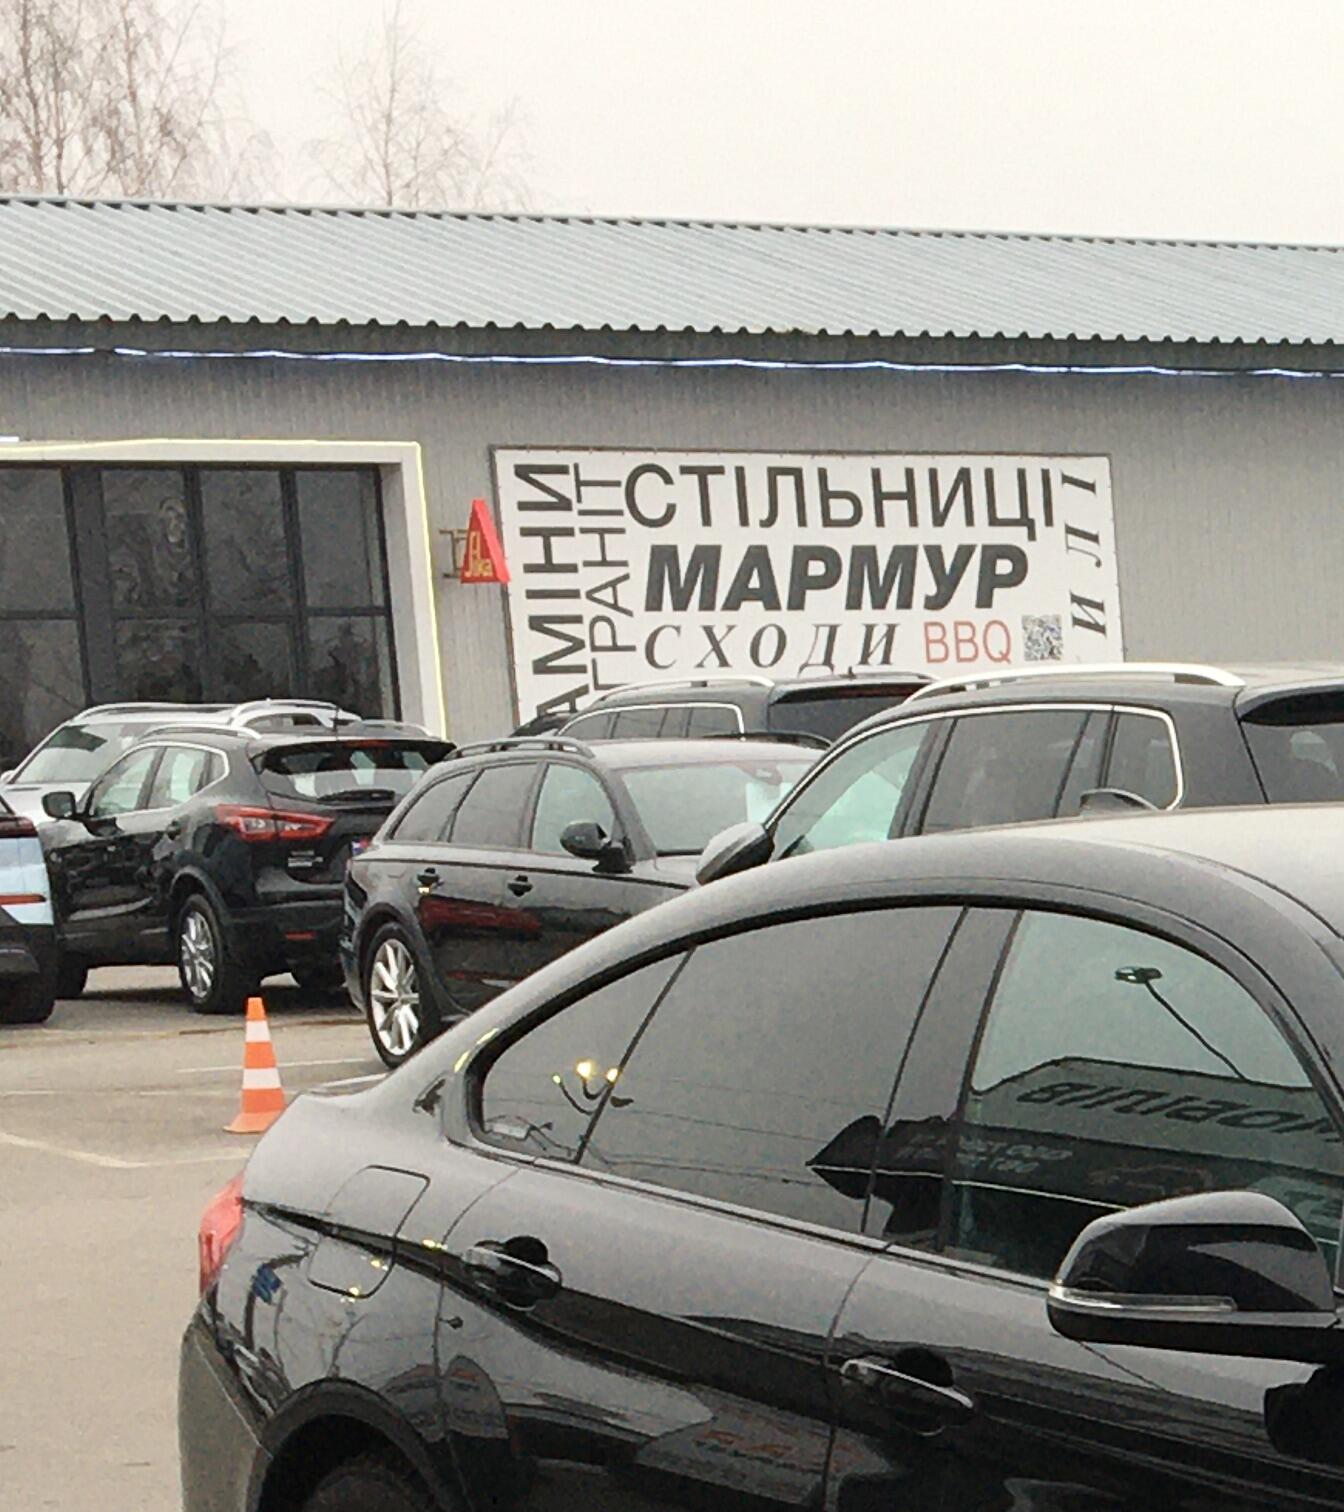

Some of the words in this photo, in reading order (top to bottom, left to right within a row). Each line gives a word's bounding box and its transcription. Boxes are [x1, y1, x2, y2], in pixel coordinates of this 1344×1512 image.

[625, 463, 1053, 541] СТІЛЬНИЦІ
[574, 463, 636, 691] ГРАНІТ
[645, 544, 1028, 611] МАРМУР
[644, 622, 901, 676] СХОДИ
[924, 619, 1012, 665] BBQ
